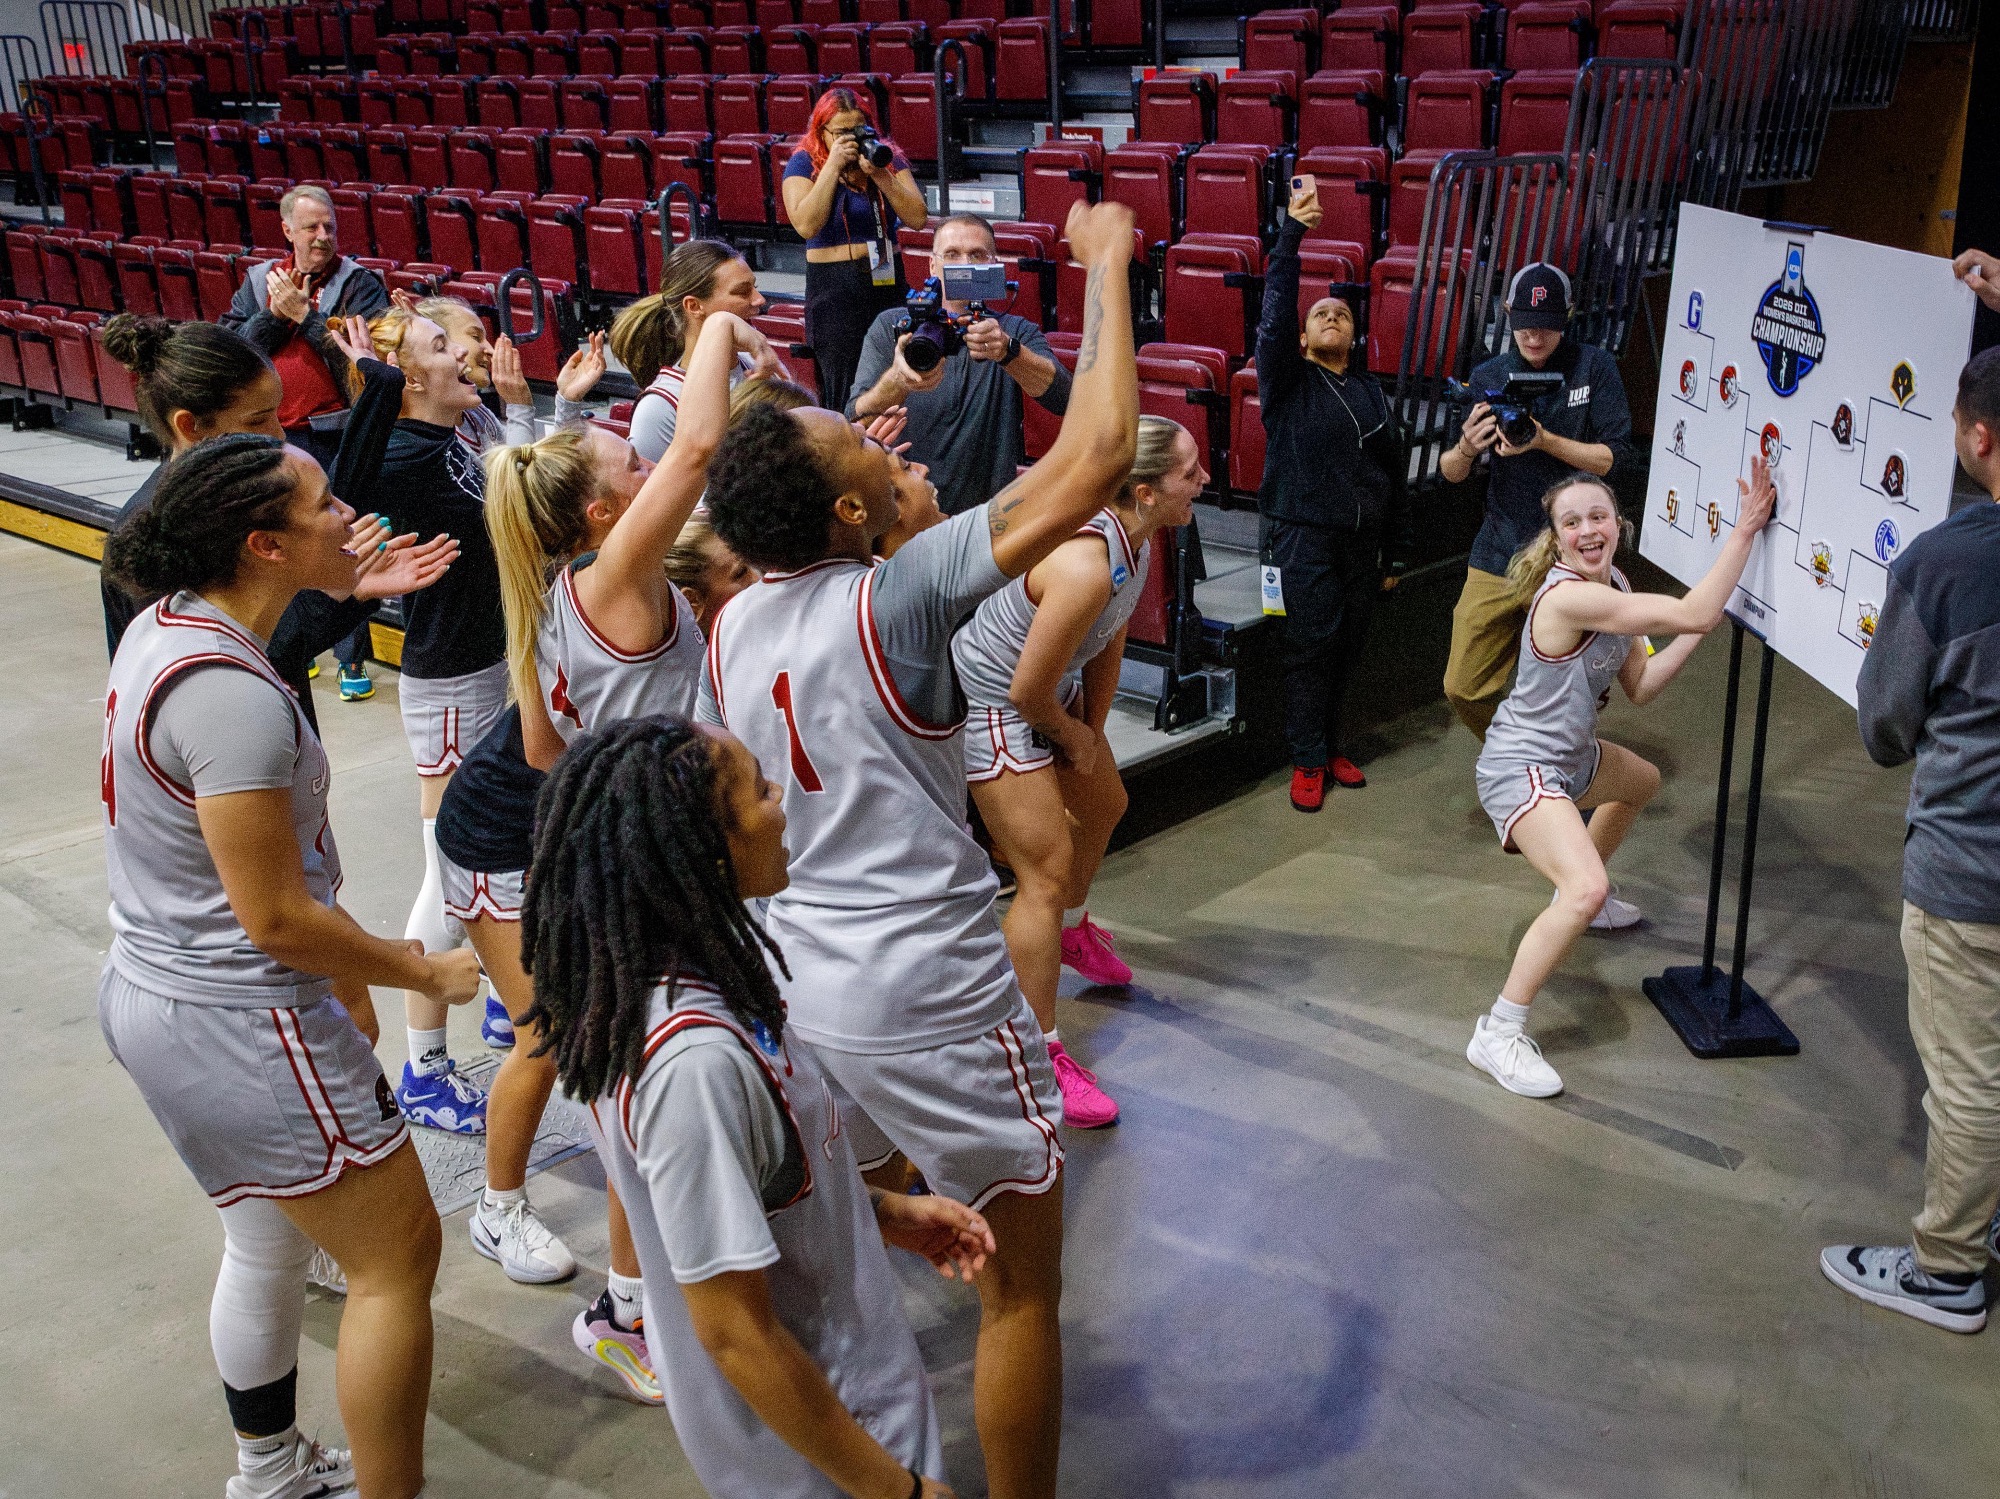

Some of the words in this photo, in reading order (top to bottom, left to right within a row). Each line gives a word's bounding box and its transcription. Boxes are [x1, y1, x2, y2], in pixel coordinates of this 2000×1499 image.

[1531, 286, 1547, 307] P
[1773, 296, 1794, 311] 2026
[1687, 291, 1702, 331] G
[1763, 306, 1786, 323] WOMEN'S
[1786, 313, 1816, 332] BASKETBALL
[1753, 315, 1824, 359] CHAMPIONSHIP
[1568, 386, 1590, 402] IUP
[771, 670, 824, 794] 1
